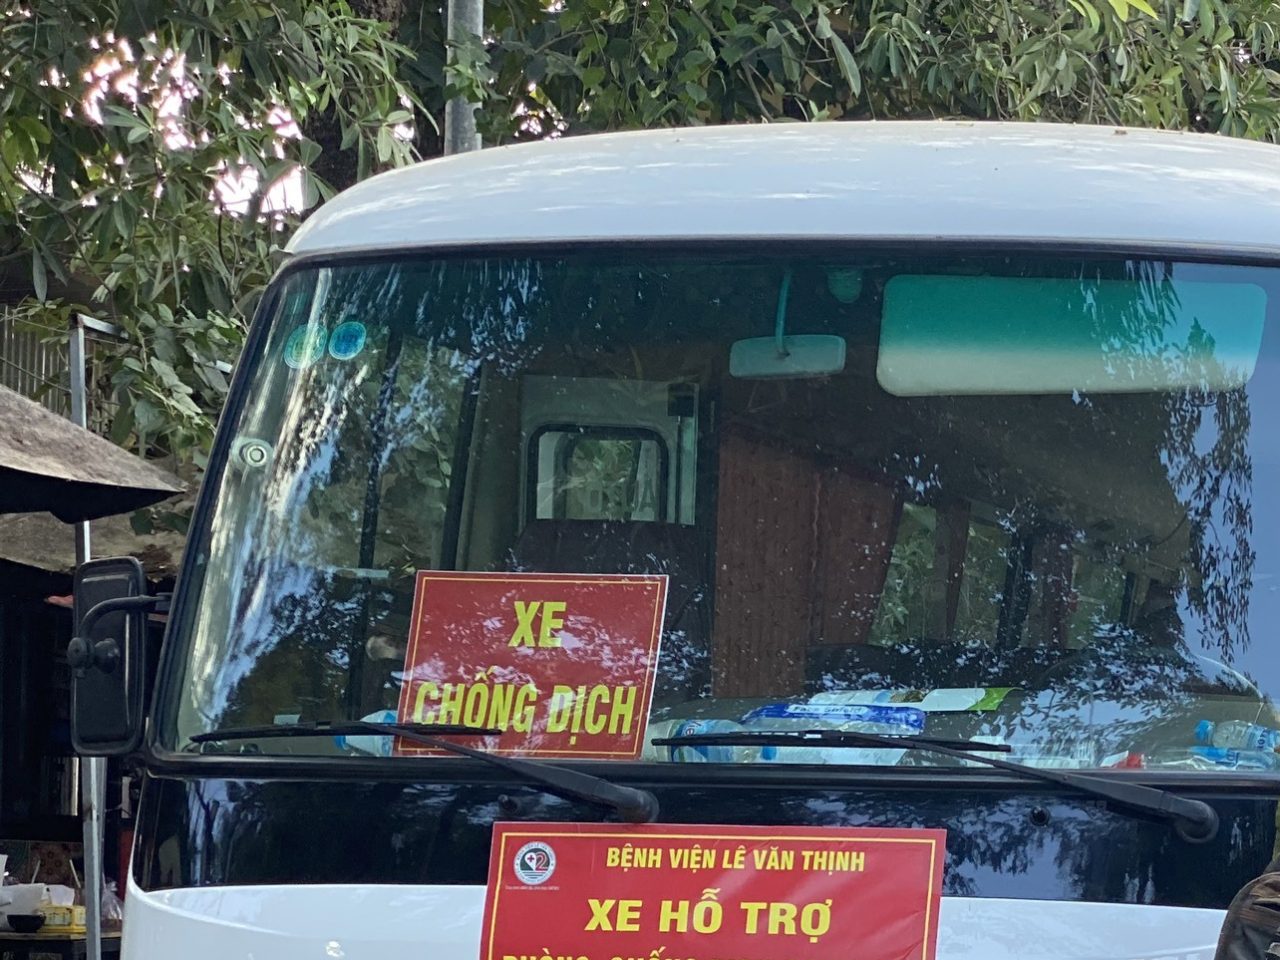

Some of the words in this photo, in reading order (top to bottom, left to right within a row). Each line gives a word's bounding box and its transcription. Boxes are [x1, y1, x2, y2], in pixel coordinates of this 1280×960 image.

[508, 600, 567, 647] XE
[413, 666, 538, 732] CHỐNG
[546, 685, 637, 745] DỊCH
[606, 843, 662, 872] BỆNH
[669, 844, 717, 873] VIỆN
[722, 845, 747, 870] LÊ
[753, 846, 795, 870] VĂN
[801, 850, 865, 876] THỊNH
[583, 898, 643, 932] XE
[658, 887, 723, 934] HỖ
[740, 898, 833, 944] TRỢ
